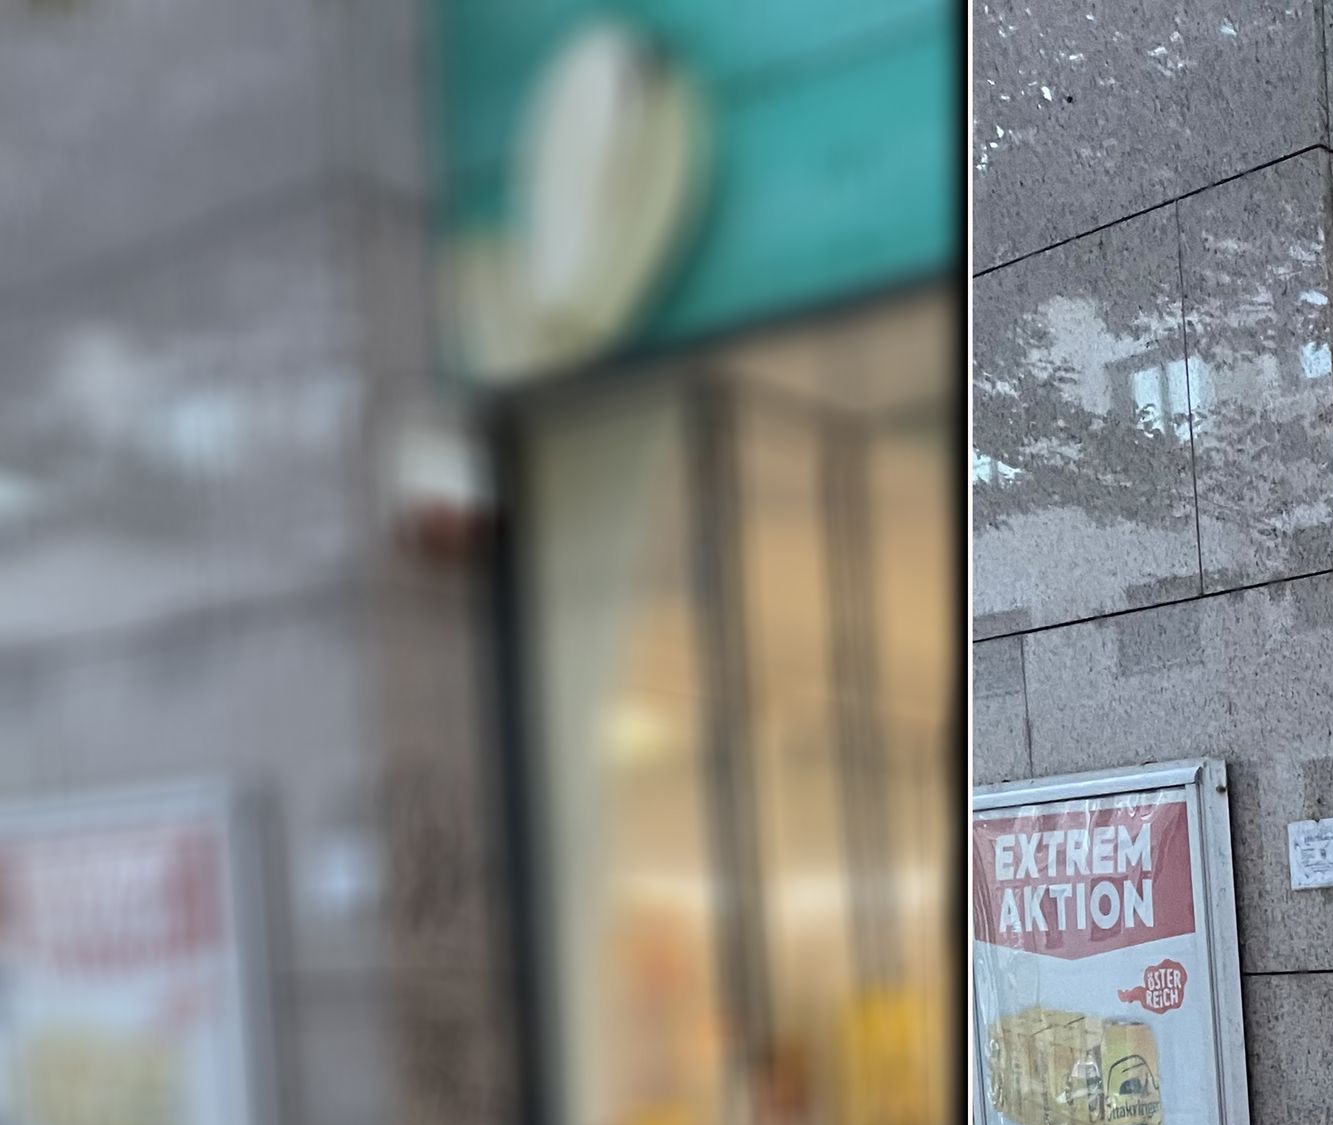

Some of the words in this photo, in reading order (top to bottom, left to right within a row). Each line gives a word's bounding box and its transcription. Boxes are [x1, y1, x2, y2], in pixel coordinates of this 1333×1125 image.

[994, 823, 1152, 881] EXTREM
[1000, 879, 1154, 933] AKTION
[1147, 968, 1182, 991] ÖSTER
